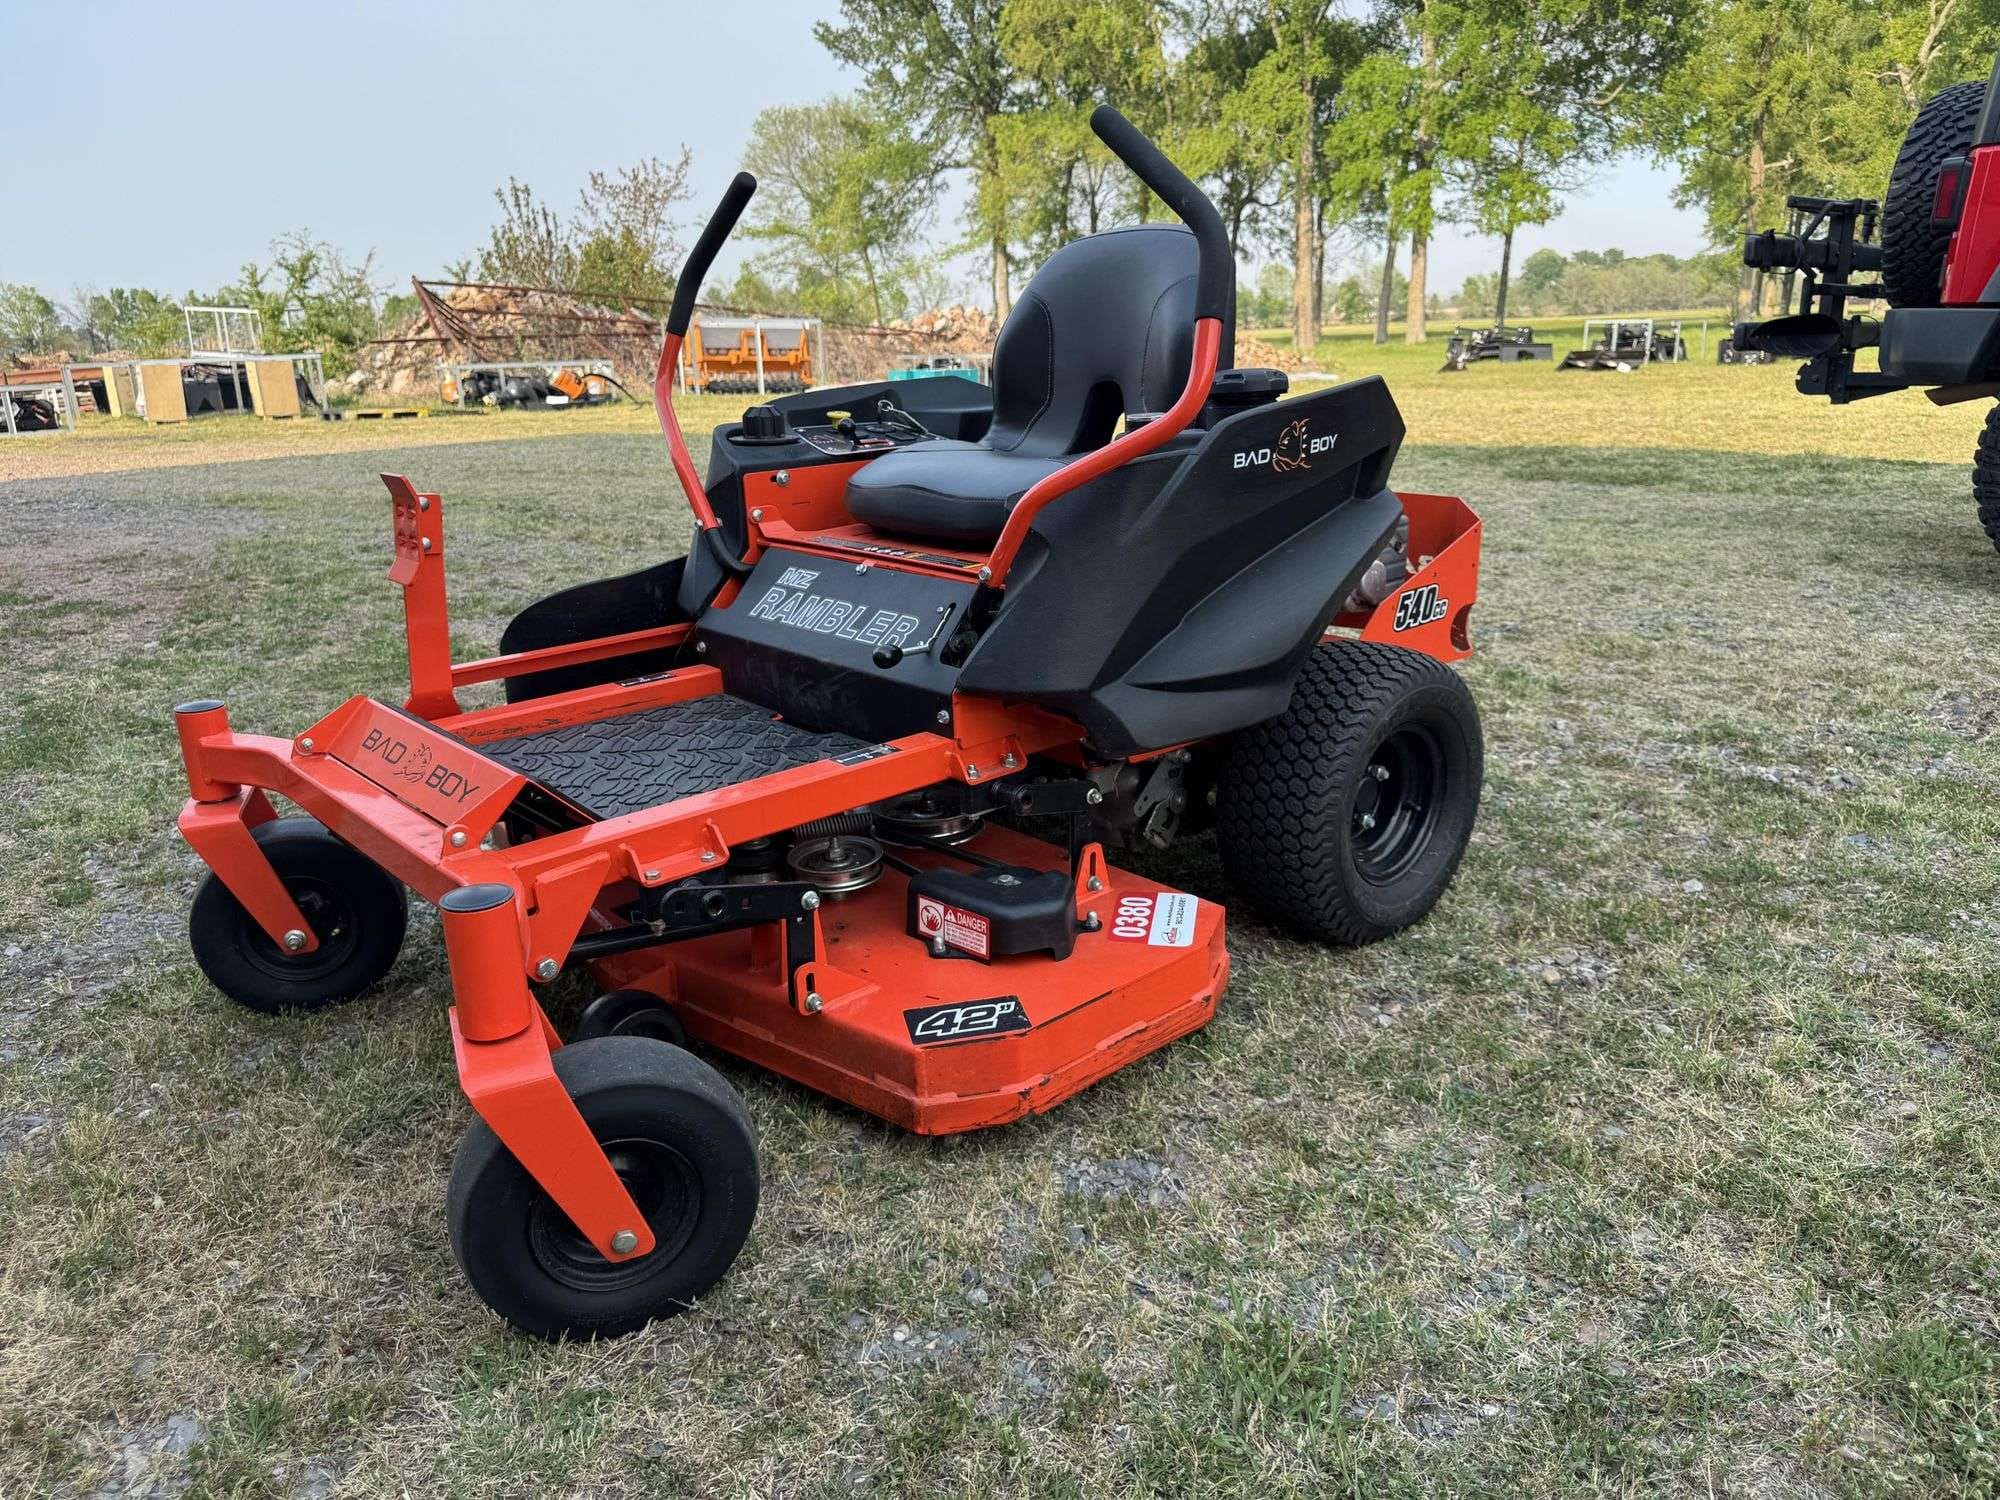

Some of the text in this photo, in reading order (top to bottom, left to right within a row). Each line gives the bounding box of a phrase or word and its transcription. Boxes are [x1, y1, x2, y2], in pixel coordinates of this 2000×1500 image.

[1233, 434, 1338, 469] BAD BOY
[777, 567, 821, 589] MZ
[750, 586, 920, 647] RAMBLER
[361, 728, 480, 803] BAD BOY
[957, 912, 988, 934] DANGER
[1112, 896, 1153, 938] 0380
